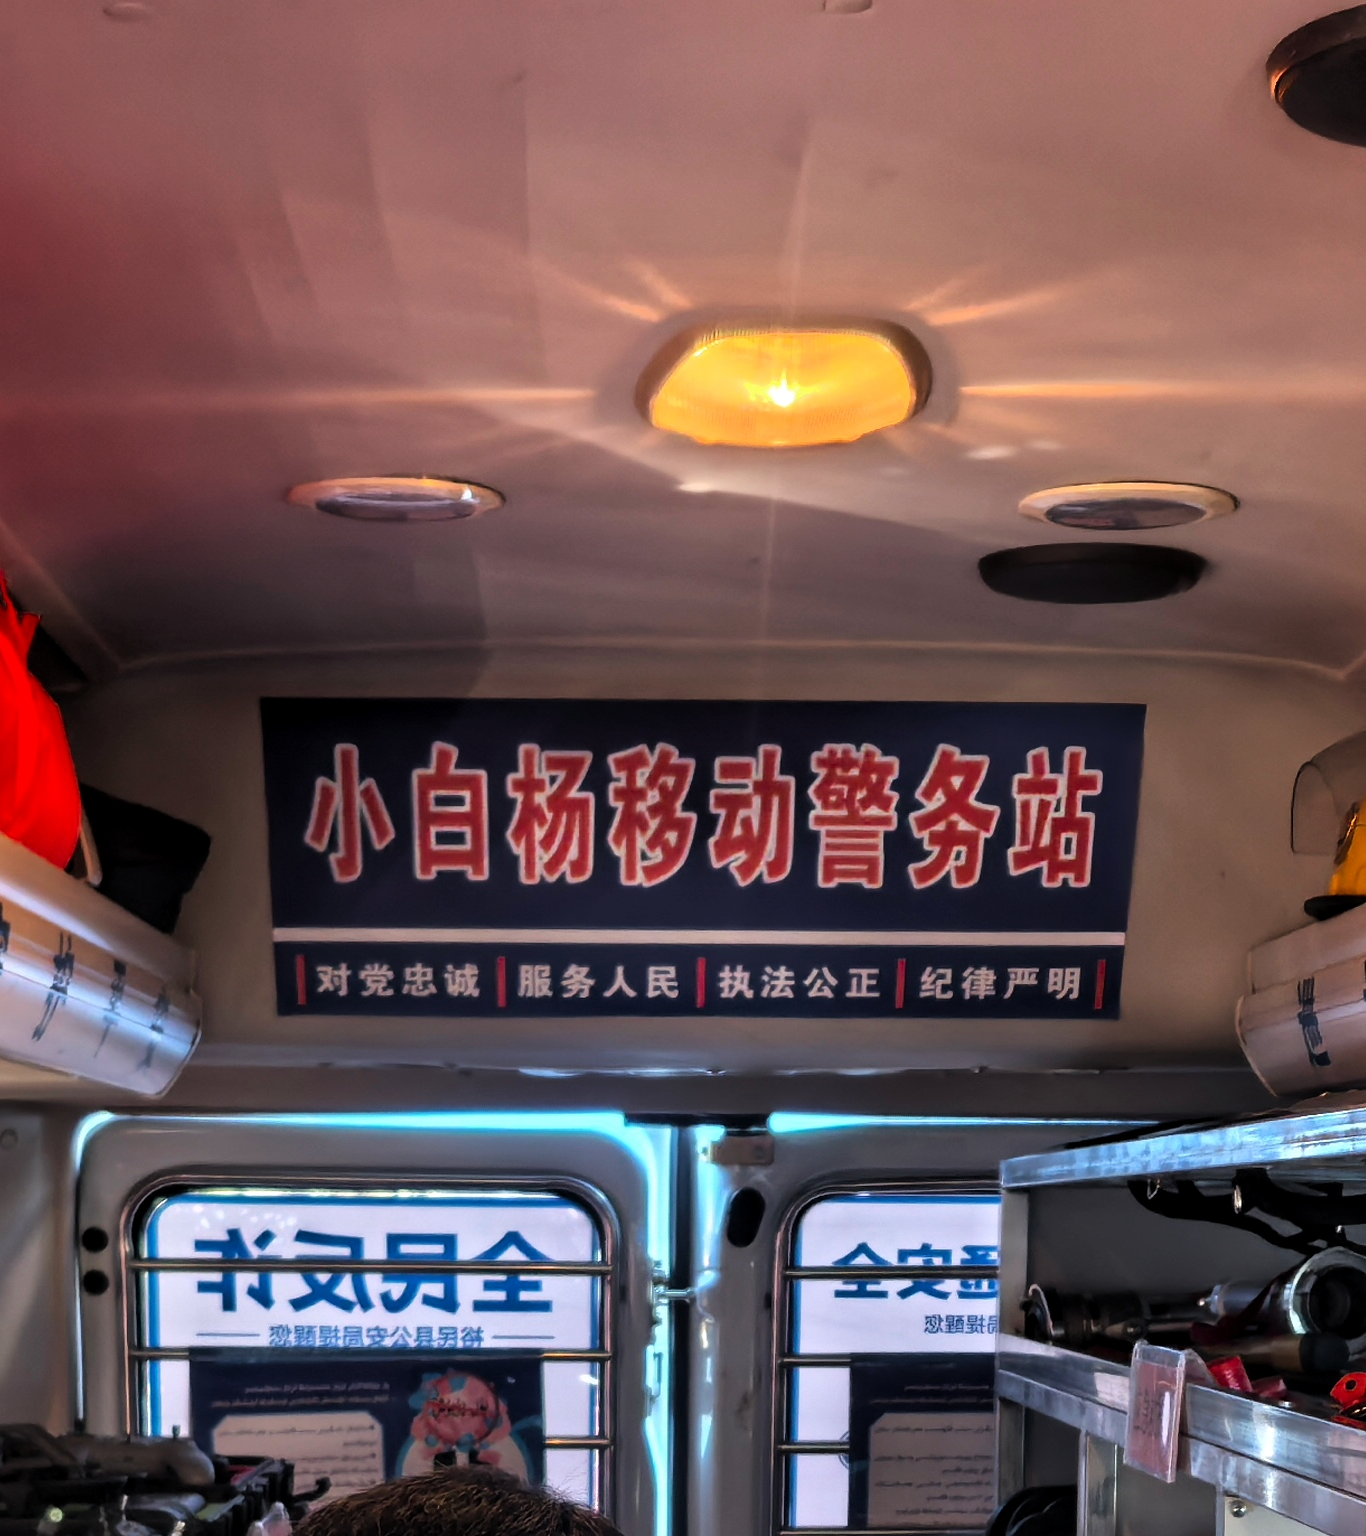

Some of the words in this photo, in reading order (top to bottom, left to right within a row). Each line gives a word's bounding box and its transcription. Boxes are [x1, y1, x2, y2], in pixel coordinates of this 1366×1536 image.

[303, 740, 1105, 889] 小白杨移动警务站
[315, 961, 481, 999] 对党忠诚
[517, 964, 682, 1001] 服务人民
[718, 965, 883, 1003] 执法公正
[919, 965, 1084, 1003] 纪律严明
